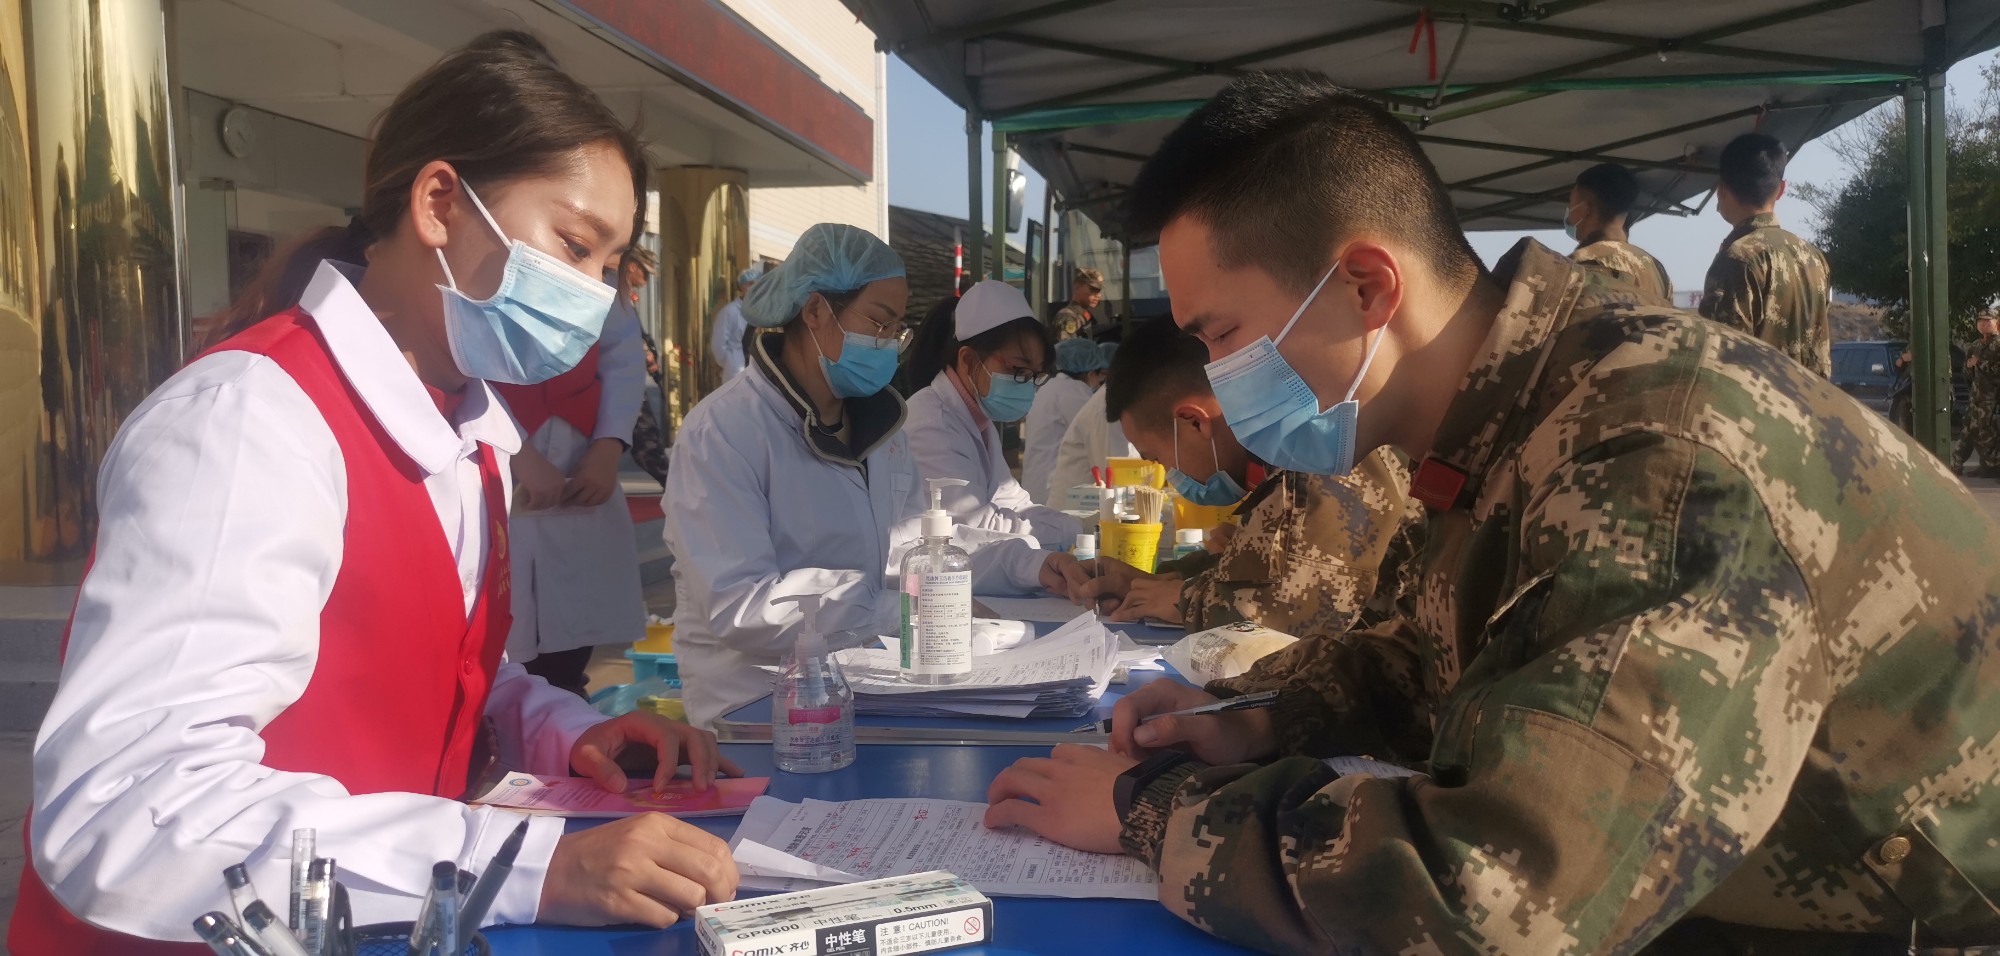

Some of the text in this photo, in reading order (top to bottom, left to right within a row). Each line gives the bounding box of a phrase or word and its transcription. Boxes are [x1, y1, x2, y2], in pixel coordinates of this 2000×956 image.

[736, 923, 800, 940] GP6600
[813, 913, 861, 926] 中性笔
[893, 903, 938, 914] 0.5mm
[908, 918, 949, 931] CAUTION!
[825, 928, 866, 948] 中性笔
[789, 940, 810, 953] 齐心
